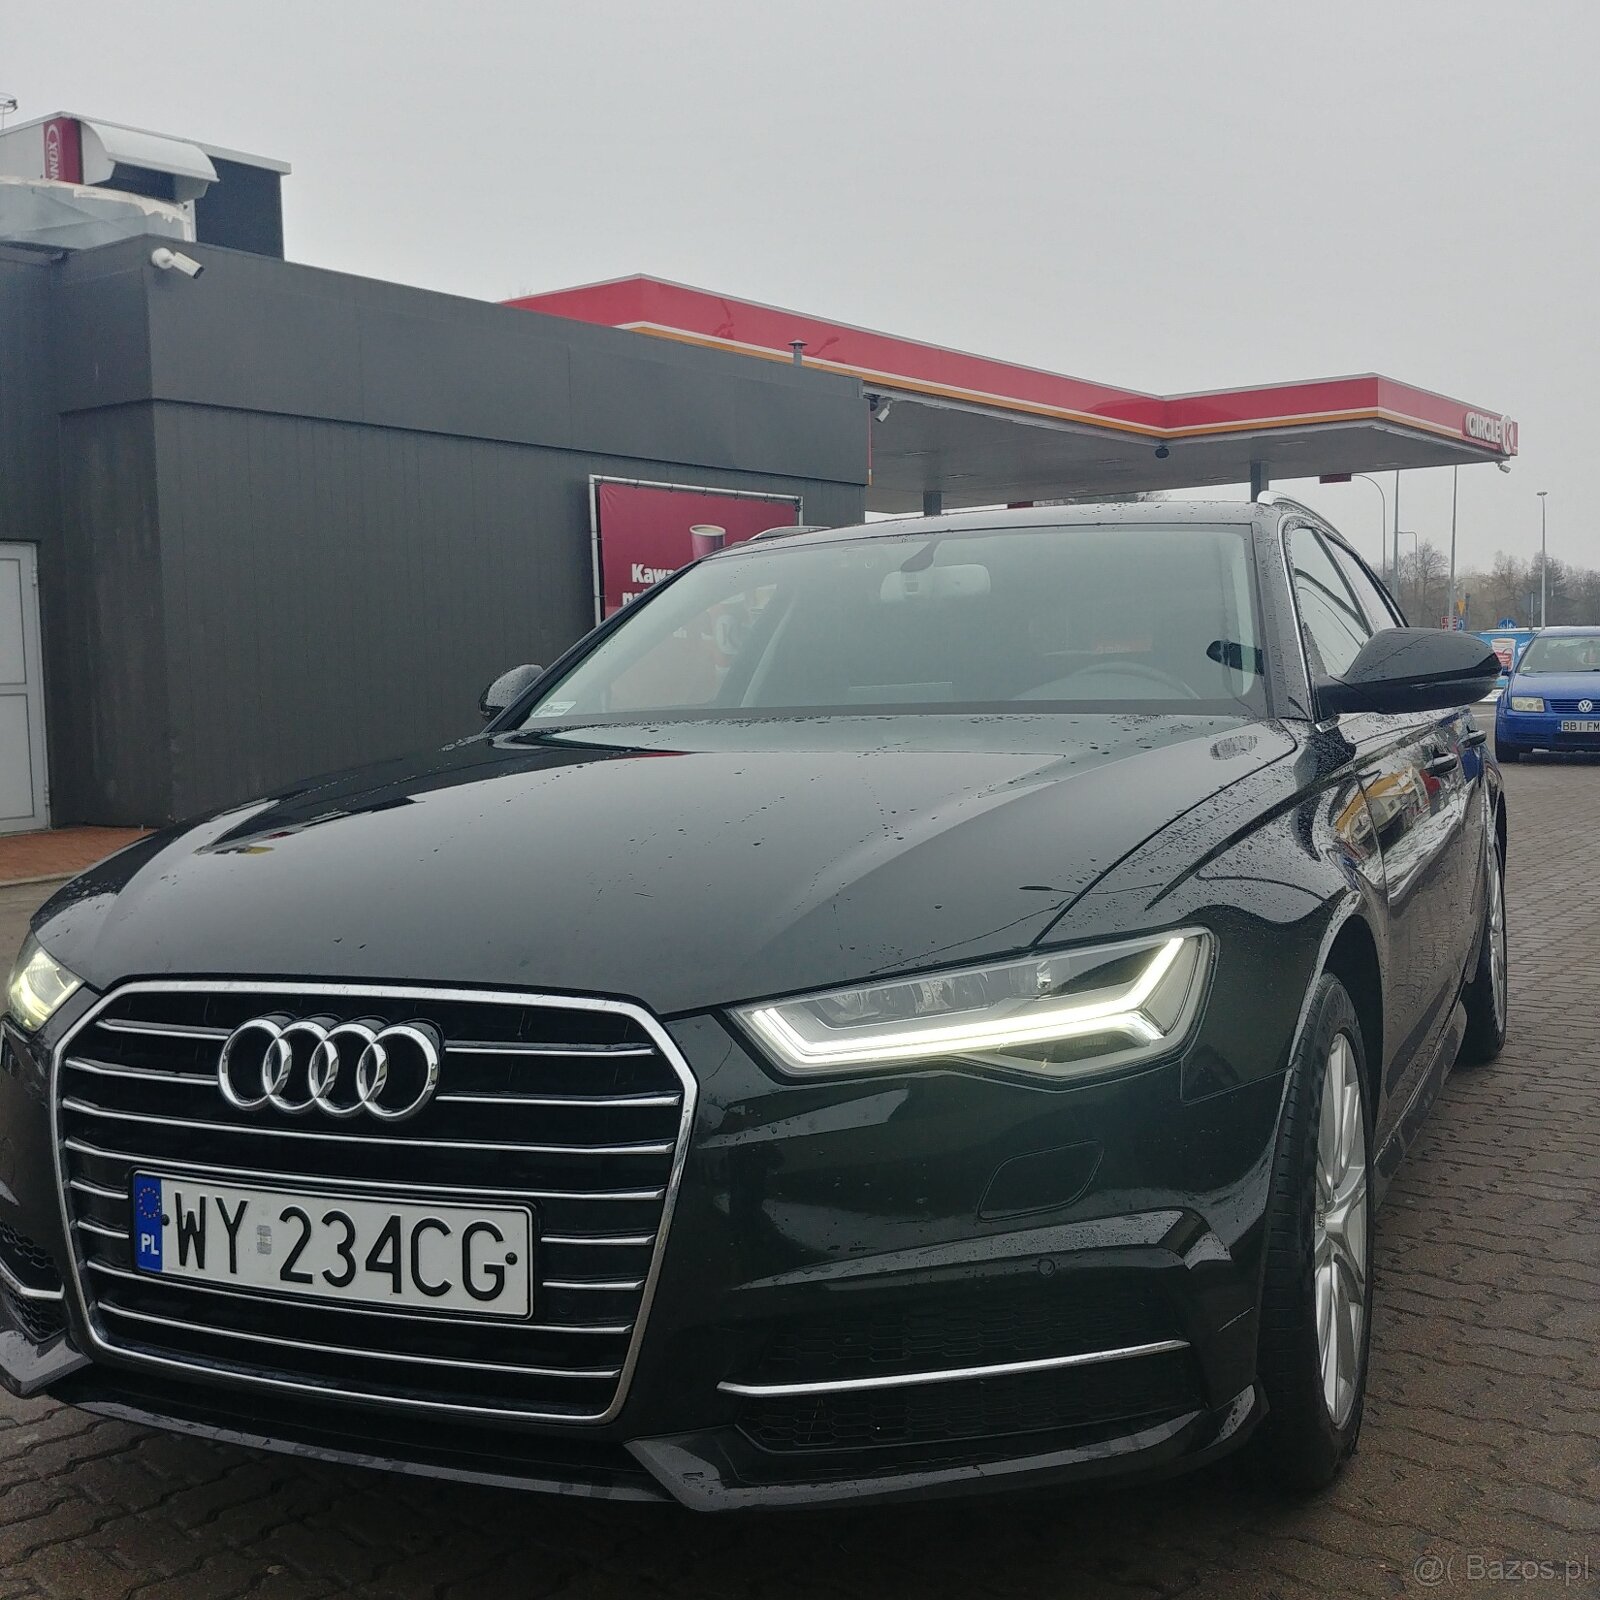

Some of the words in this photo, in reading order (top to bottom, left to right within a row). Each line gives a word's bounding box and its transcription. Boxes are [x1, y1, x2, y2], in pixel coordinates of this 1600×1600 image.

[1466, 412, 1501, 444] CIRCLE
[141, 1233, 160, 1256] PL
[174, 1192, 248, 1274] WY
[278, 1205, 506, 1301] 234CG
